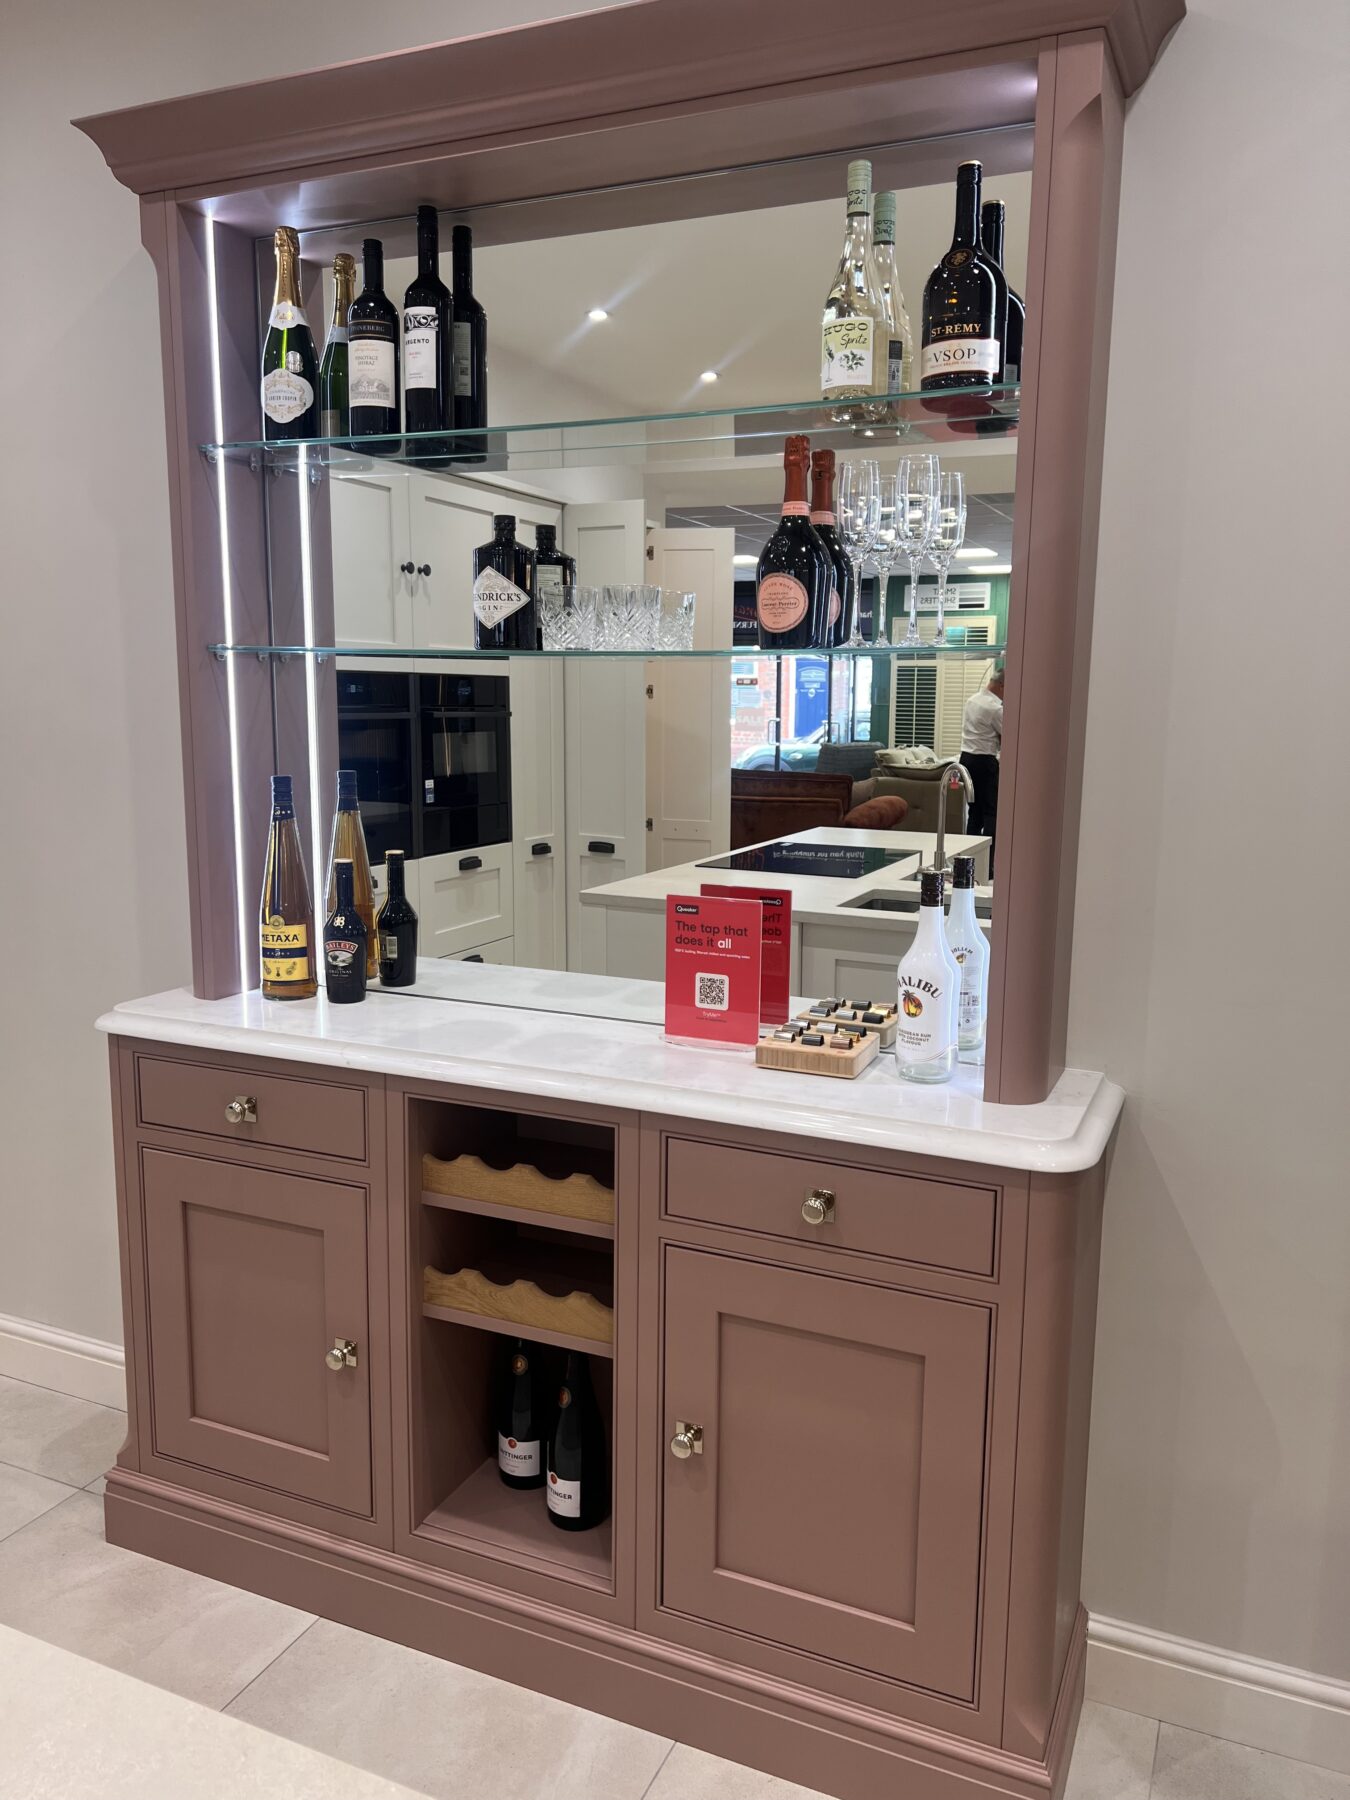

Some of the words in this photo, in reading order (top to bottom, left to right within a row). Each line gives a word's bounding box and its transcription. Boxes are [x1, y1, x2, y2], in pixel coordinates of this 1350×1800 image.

[823, 322, 868, 337] HUGO
[840, 333, 868, 350] Spritz
[933, 347, 977, 363] VSOP
[473, 591, 522, 602] ENDRICK'S
[675, 920, 697, 932] The
[700, 924, 720, 936] tap
[724, 925, 748, 937] that
[325, 942, 356, 951] BAILEYS
[675, 934, 703, 946] does
[706, 936, 714, 947] it
[717, 938, 732, 949] all
